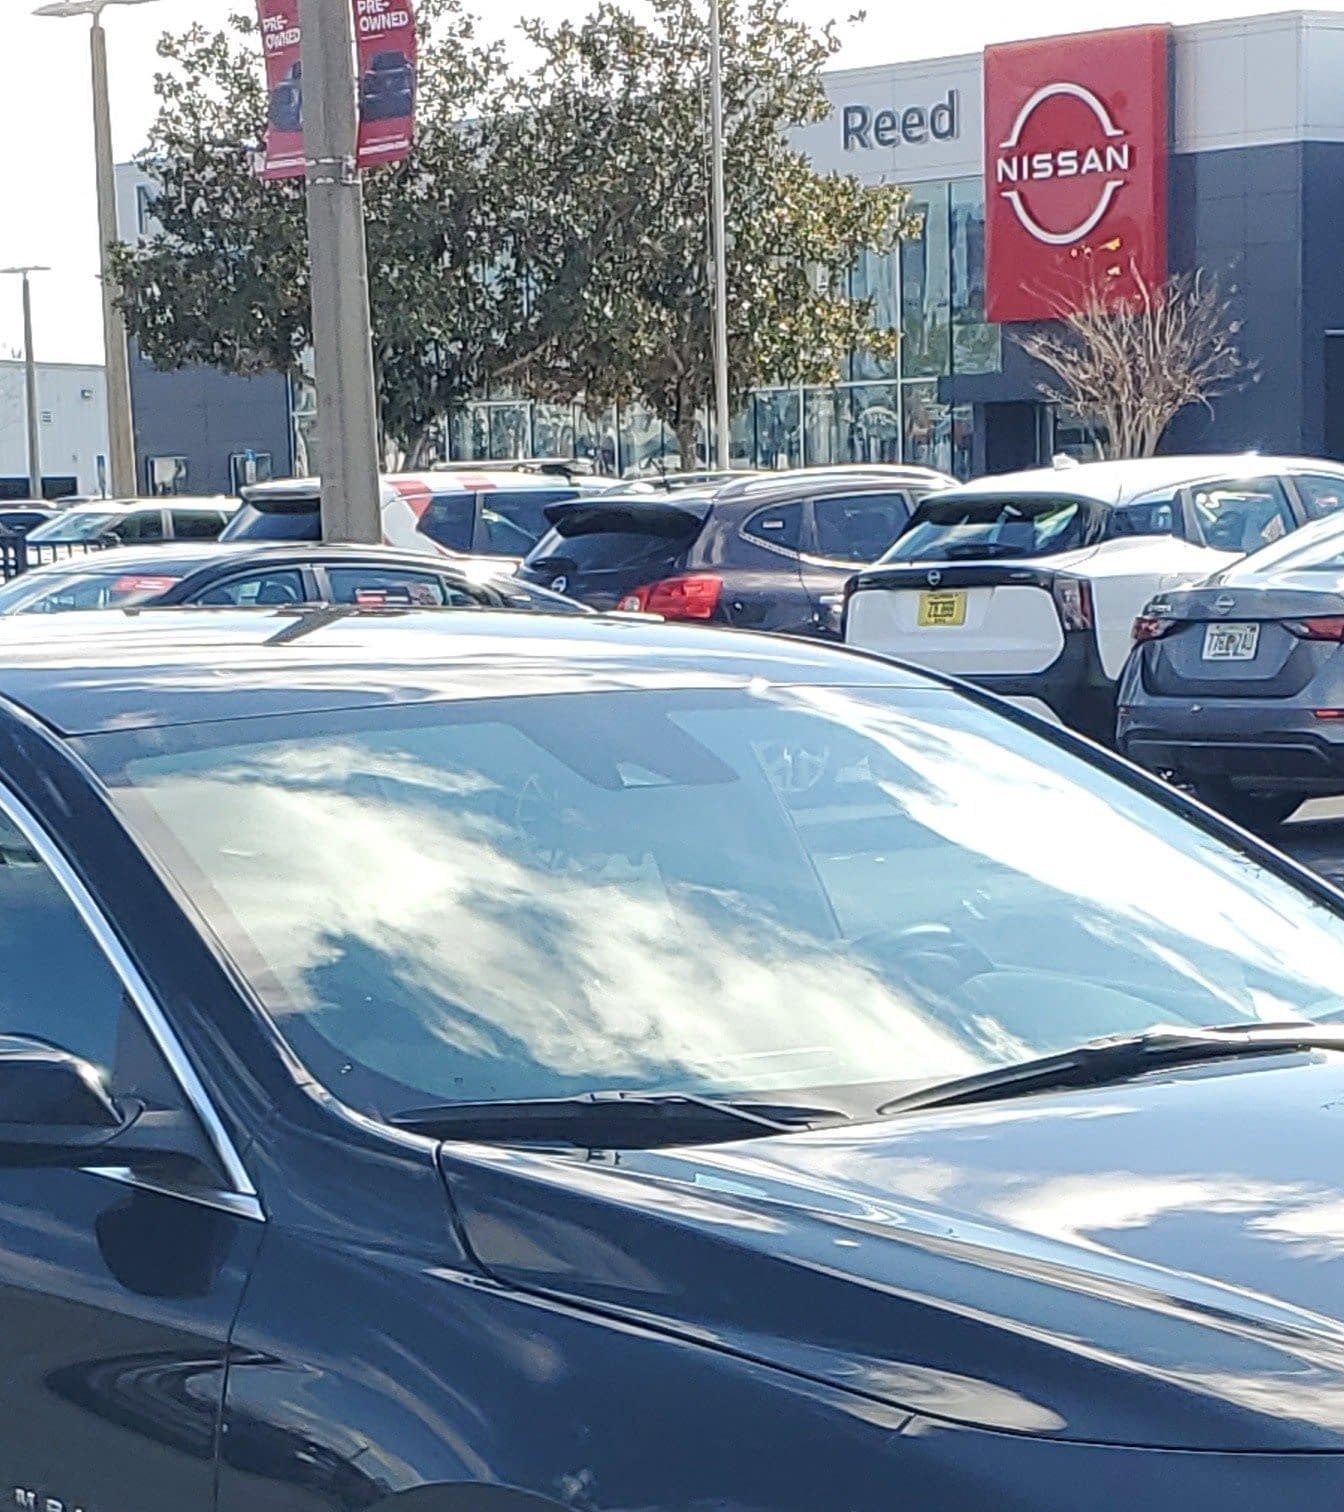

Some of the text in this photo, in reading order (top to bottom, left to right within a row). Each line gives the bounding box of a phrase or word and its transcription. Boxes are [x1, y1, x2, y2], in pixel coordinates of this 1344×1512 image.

[358, 0, 389, 15] PRE-
[263, 15, 288, 32] PRE-
[359, 11, 409, 32] OWNED
[265, 28, 301, 50] OWNED
[843, 89, 958, 150] Reed
[997, 143, 1129, 183] NISSAN
